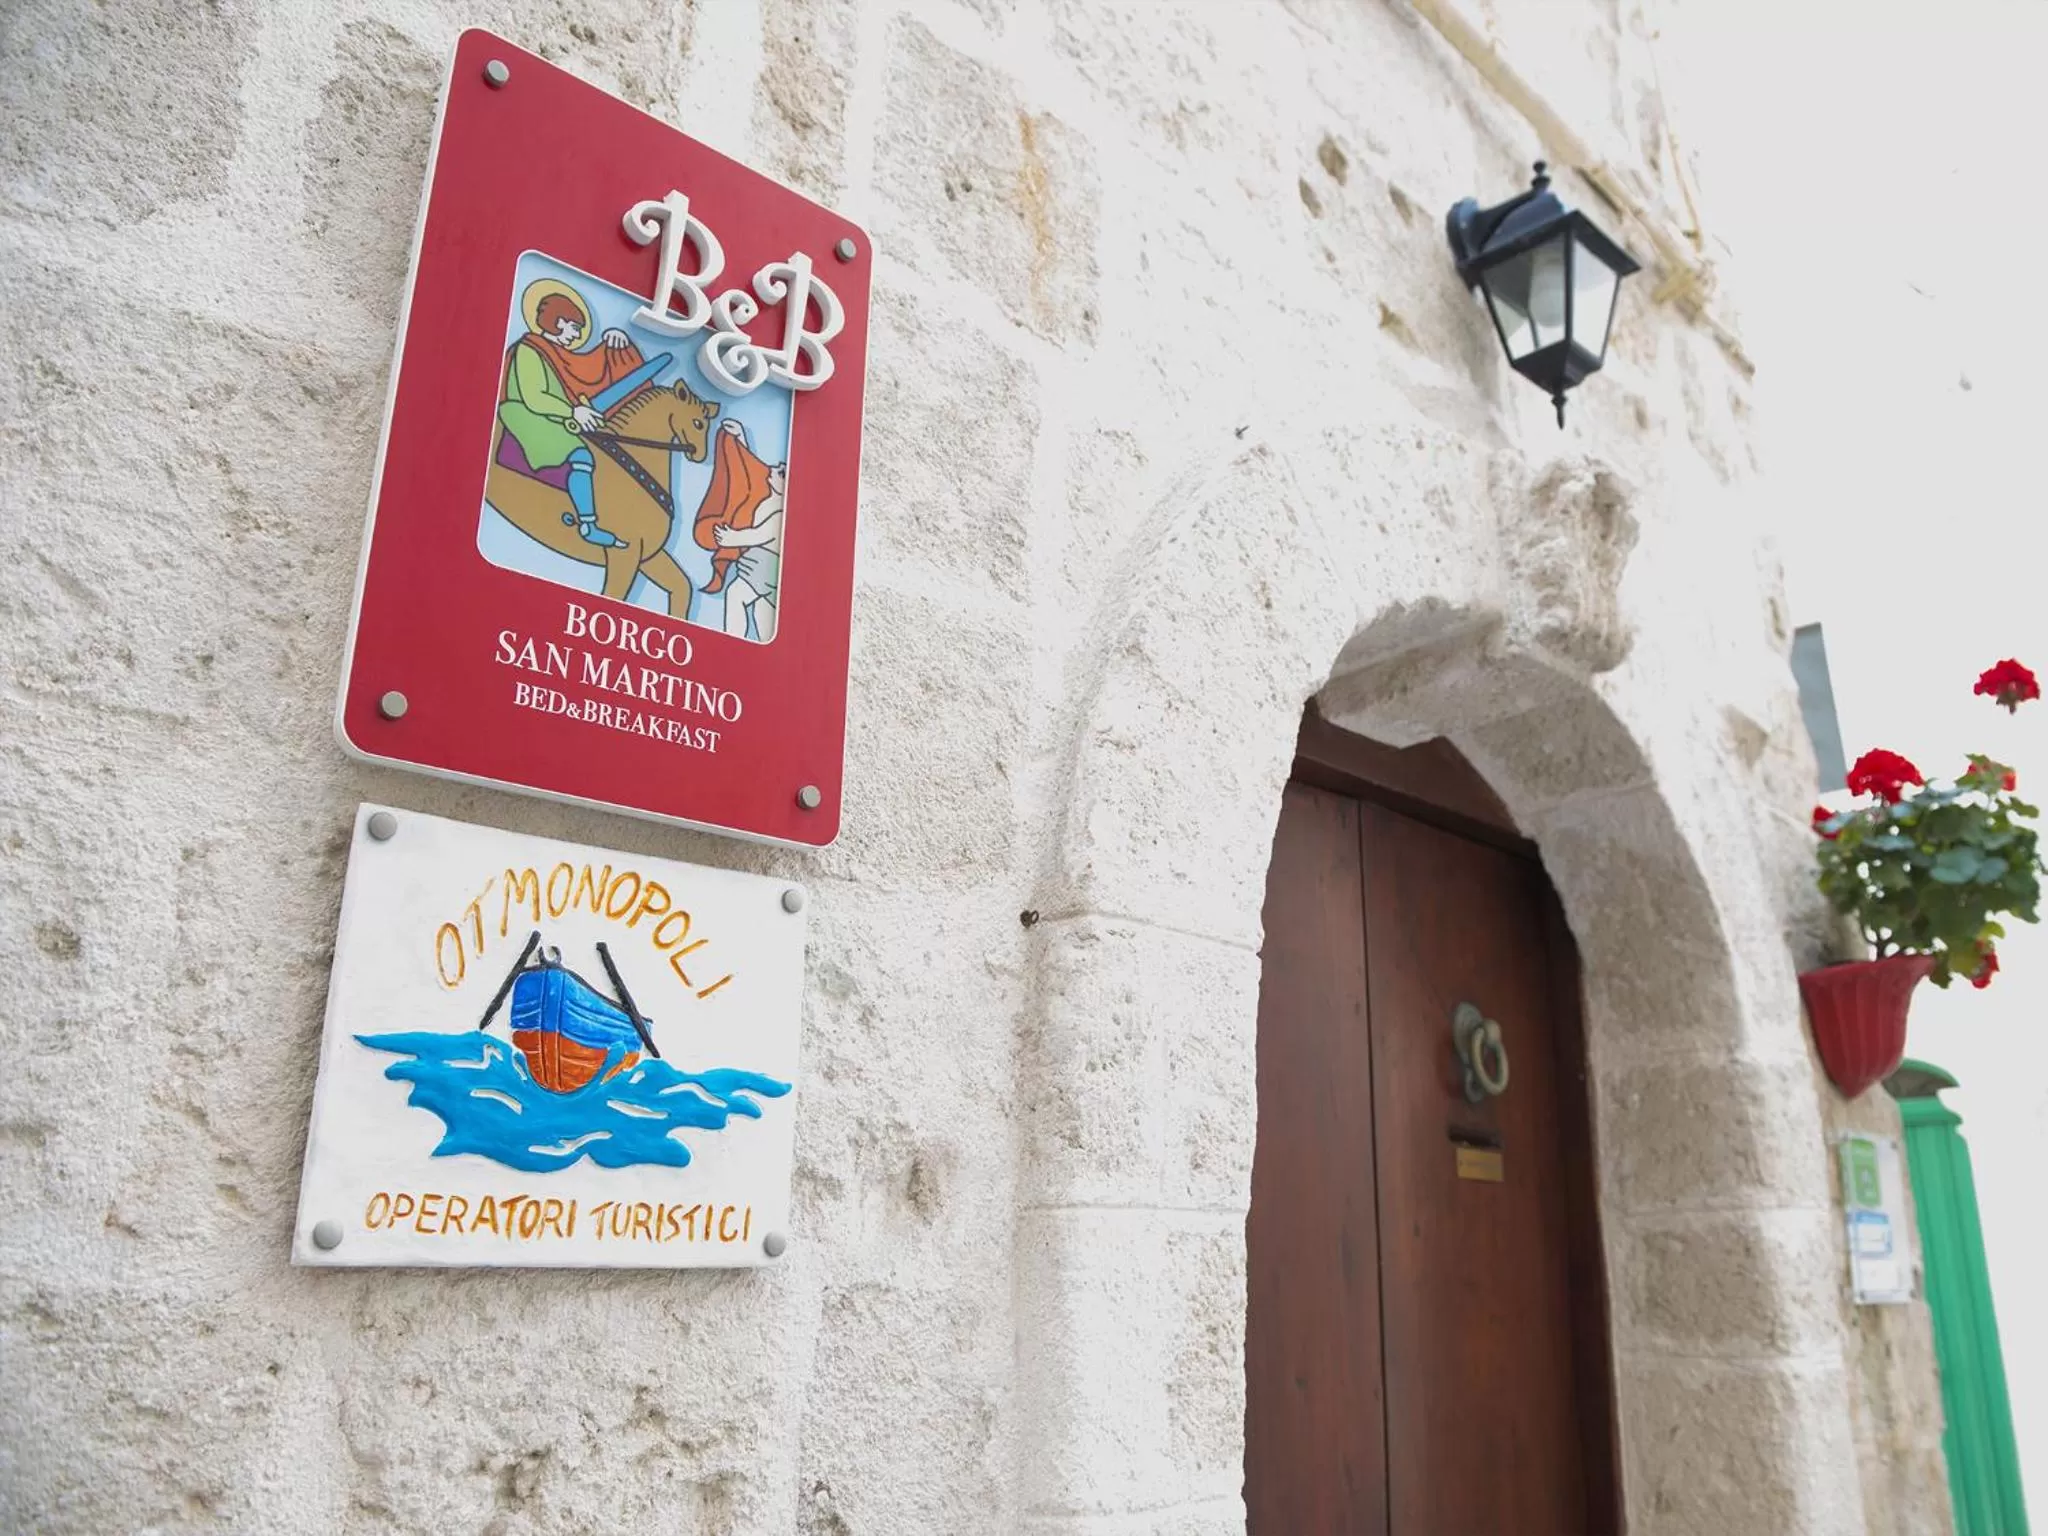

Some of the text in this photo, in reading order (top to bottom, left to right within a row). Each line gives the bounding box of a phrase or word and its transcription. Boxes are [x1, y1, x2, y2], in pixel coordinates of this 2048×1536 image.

[622, 189, 845, 397] B&B
[495, 629, 743, 722] SAN MARTINO
[563, 602, 694, 667] BORGO
[513, 681, 721, 753] BED&BREAKFAST
[499, 861, 734, 999] MONOPOLI
[364, 1191, 752, 1243] OPERATORI TURISTICI
